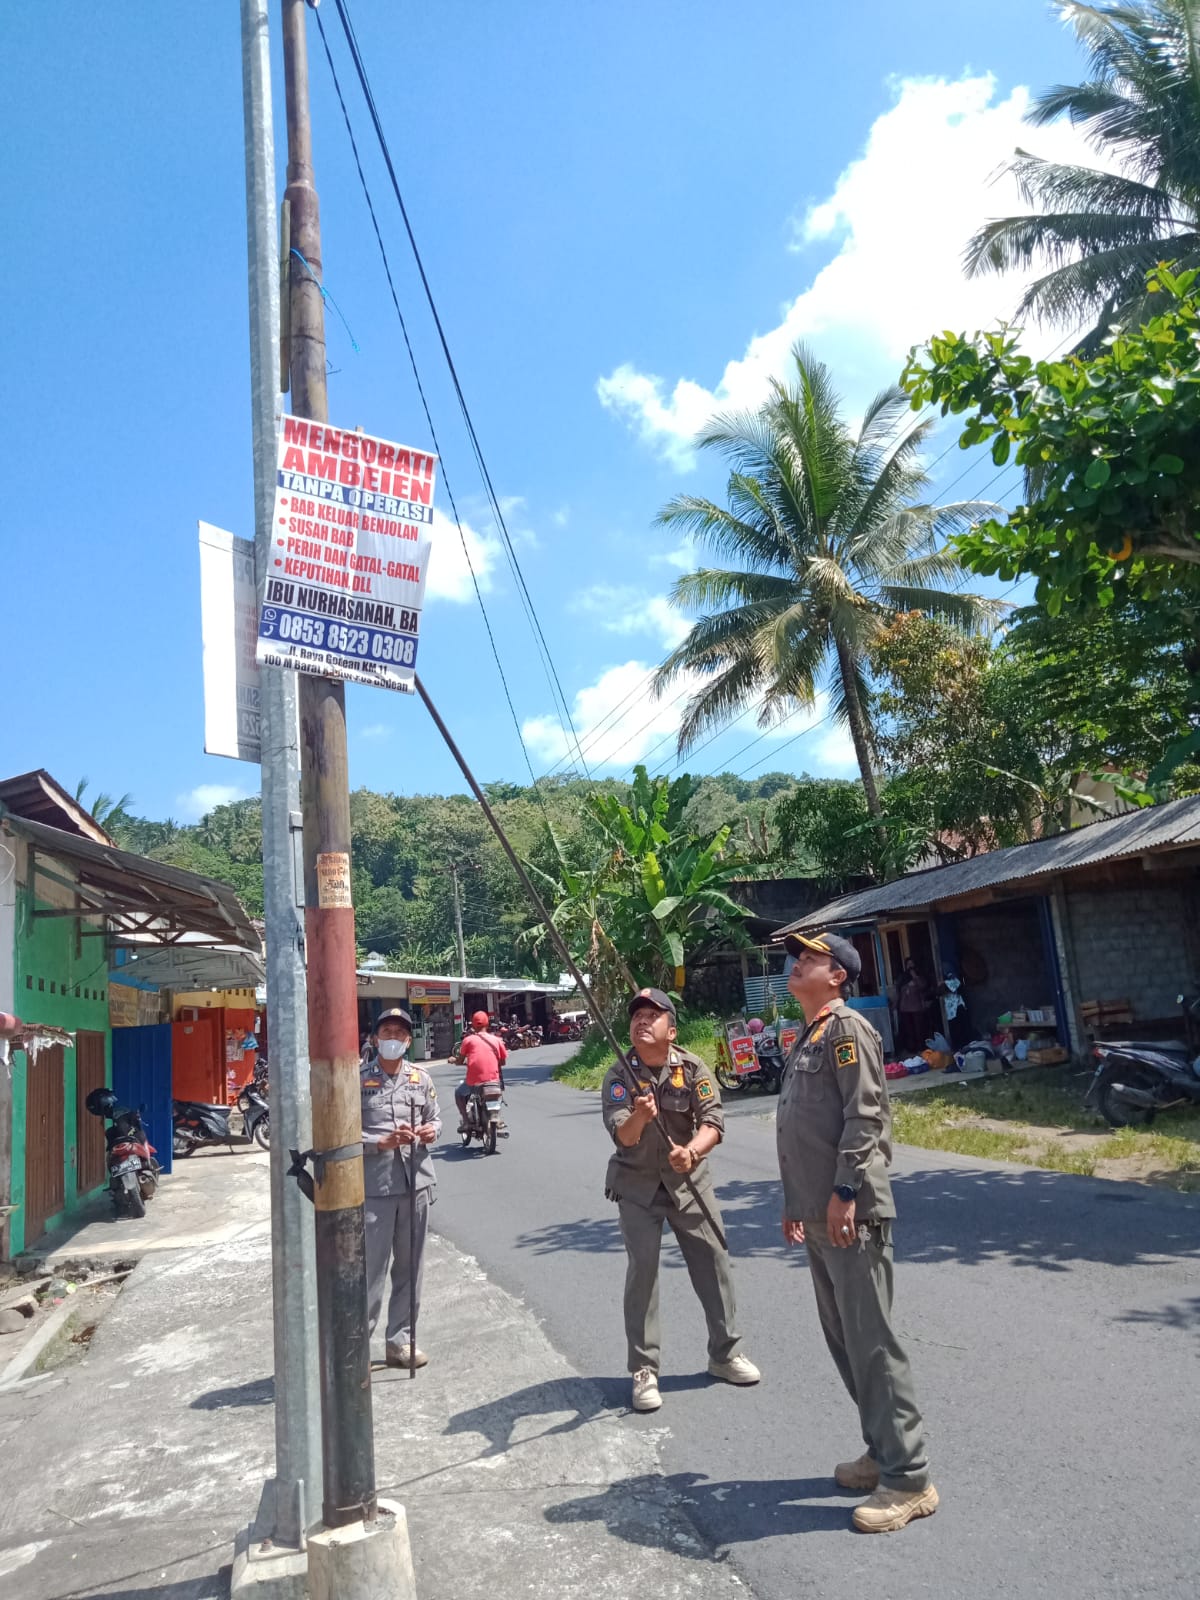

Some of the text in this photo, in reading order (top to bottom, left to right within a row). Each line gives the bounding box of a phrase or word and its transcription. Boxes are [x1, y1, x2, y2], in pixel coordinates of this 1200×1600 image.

[283, 418, 433, 480] MENGOBATI
[281, 473, 429, 522] TANPA OPERASI
[282, 447, 431, 505] AMBEIEN
[288, 517, 355, 548] SUSAH BAB
[290, 496, 419, 541] BAB KELUAR BENJOLAN
[287, 536, 420, 583] PERIH DAN GATAL-GATAL
[266, 580, 418, 633] IBU NURHASANAH, BA
[352, 575, 372, 594] DLL
[263, 653, 282, 666] 100
[279, 613, 325, 646] 0853
[327, 624, 369, 655] 8523
[372, 633, 415, 664] 0308
[300, 648, 324, 662] Raya
